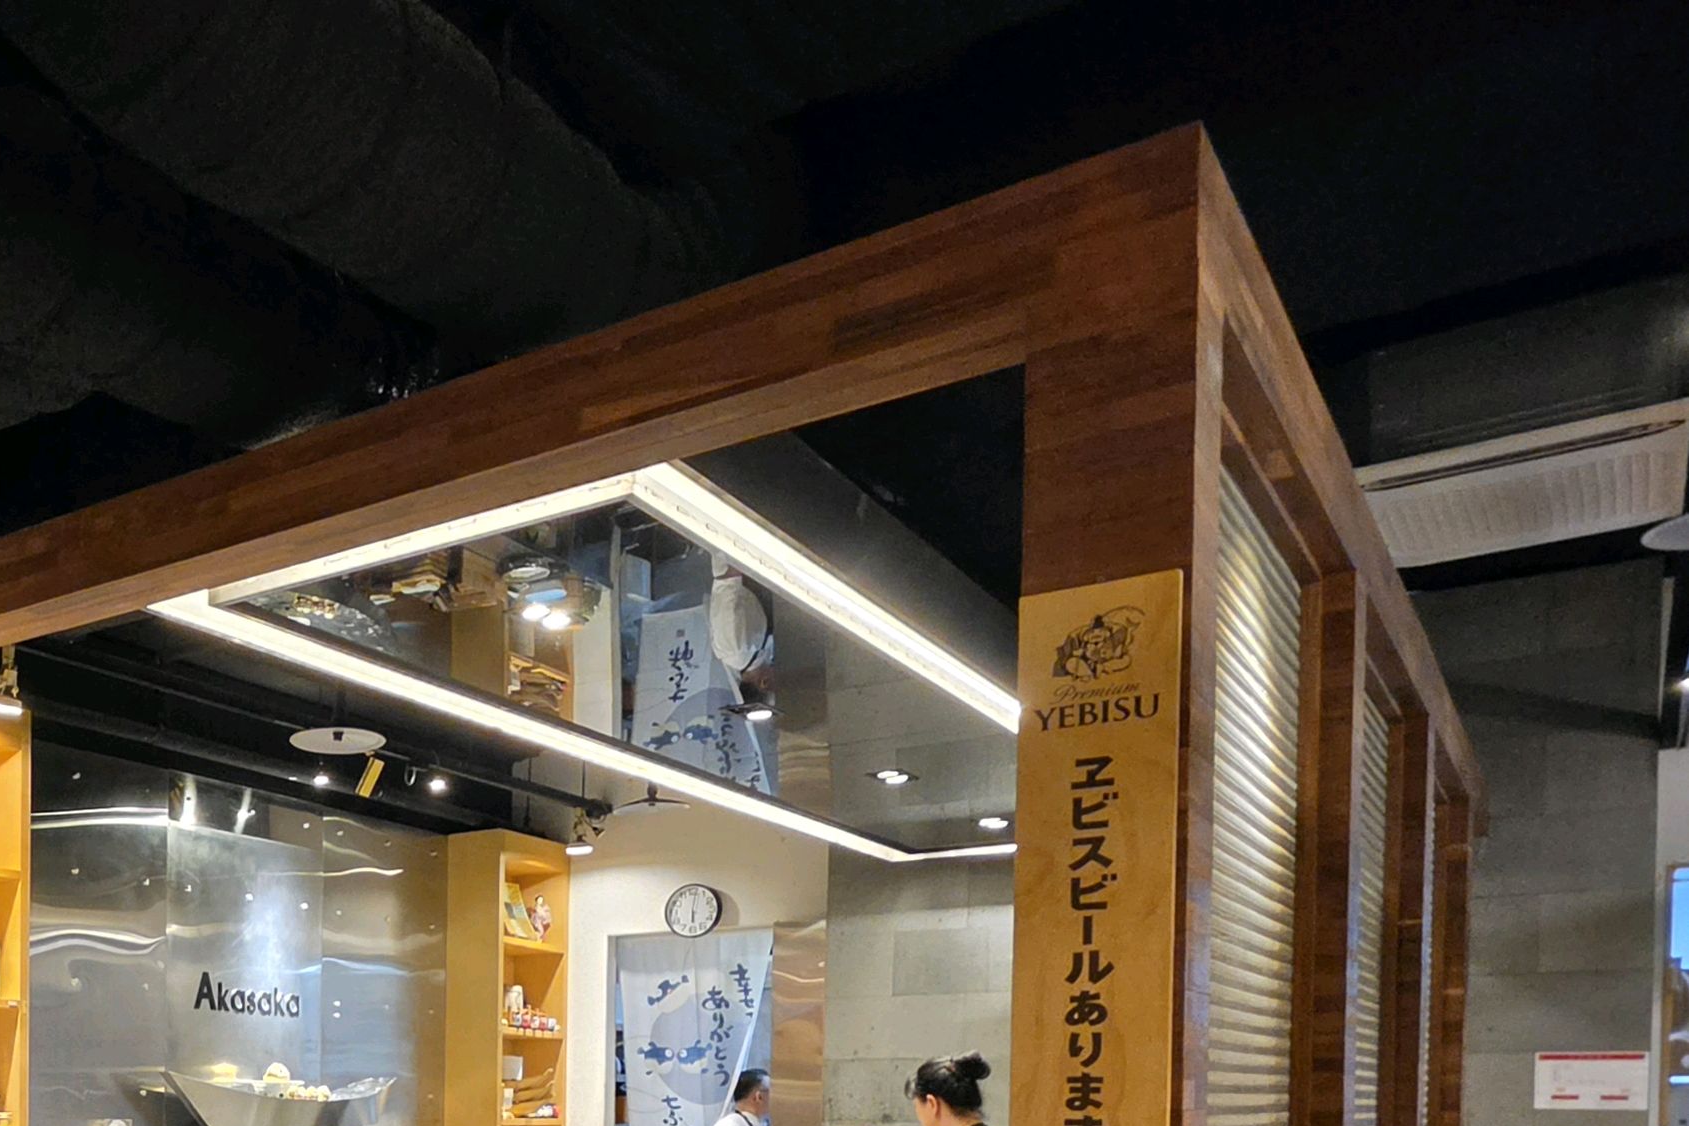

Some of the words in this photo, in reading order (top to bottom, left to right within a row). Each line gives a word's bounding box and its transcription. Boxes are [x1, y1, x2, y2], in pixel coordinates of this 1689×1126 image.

[1034, 693, 1160, 731] YEBISU
[1049, 682, 1141, 704] Premium
[193, 971, 300, 1018] Akasaka
[702, 986, 733, 1087] ありがとう
